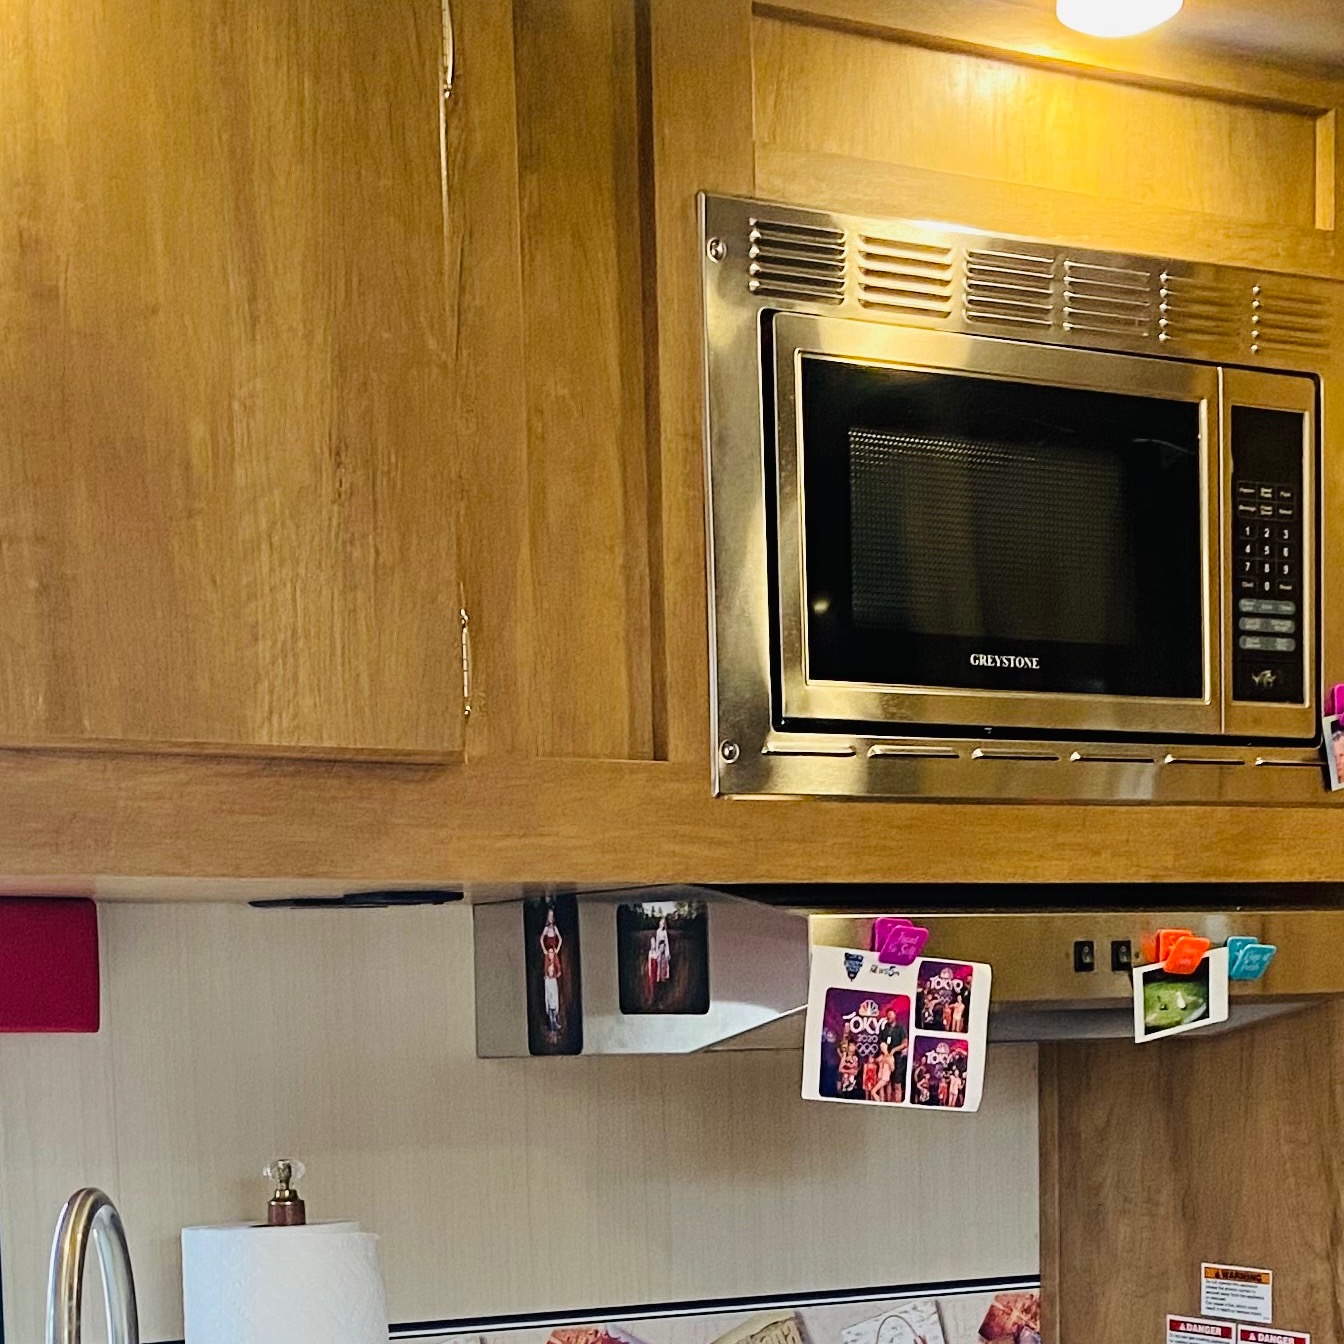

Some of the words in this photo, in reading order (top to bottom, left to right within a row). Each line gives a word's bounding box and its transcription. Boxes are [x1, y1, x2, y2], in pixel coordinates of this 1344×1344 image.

[969, 653, 1040, 669] GREYSTONE
[843, 1012, 888, 1034] OKY
[1186, 1323, 1222, 1336] DANGER
